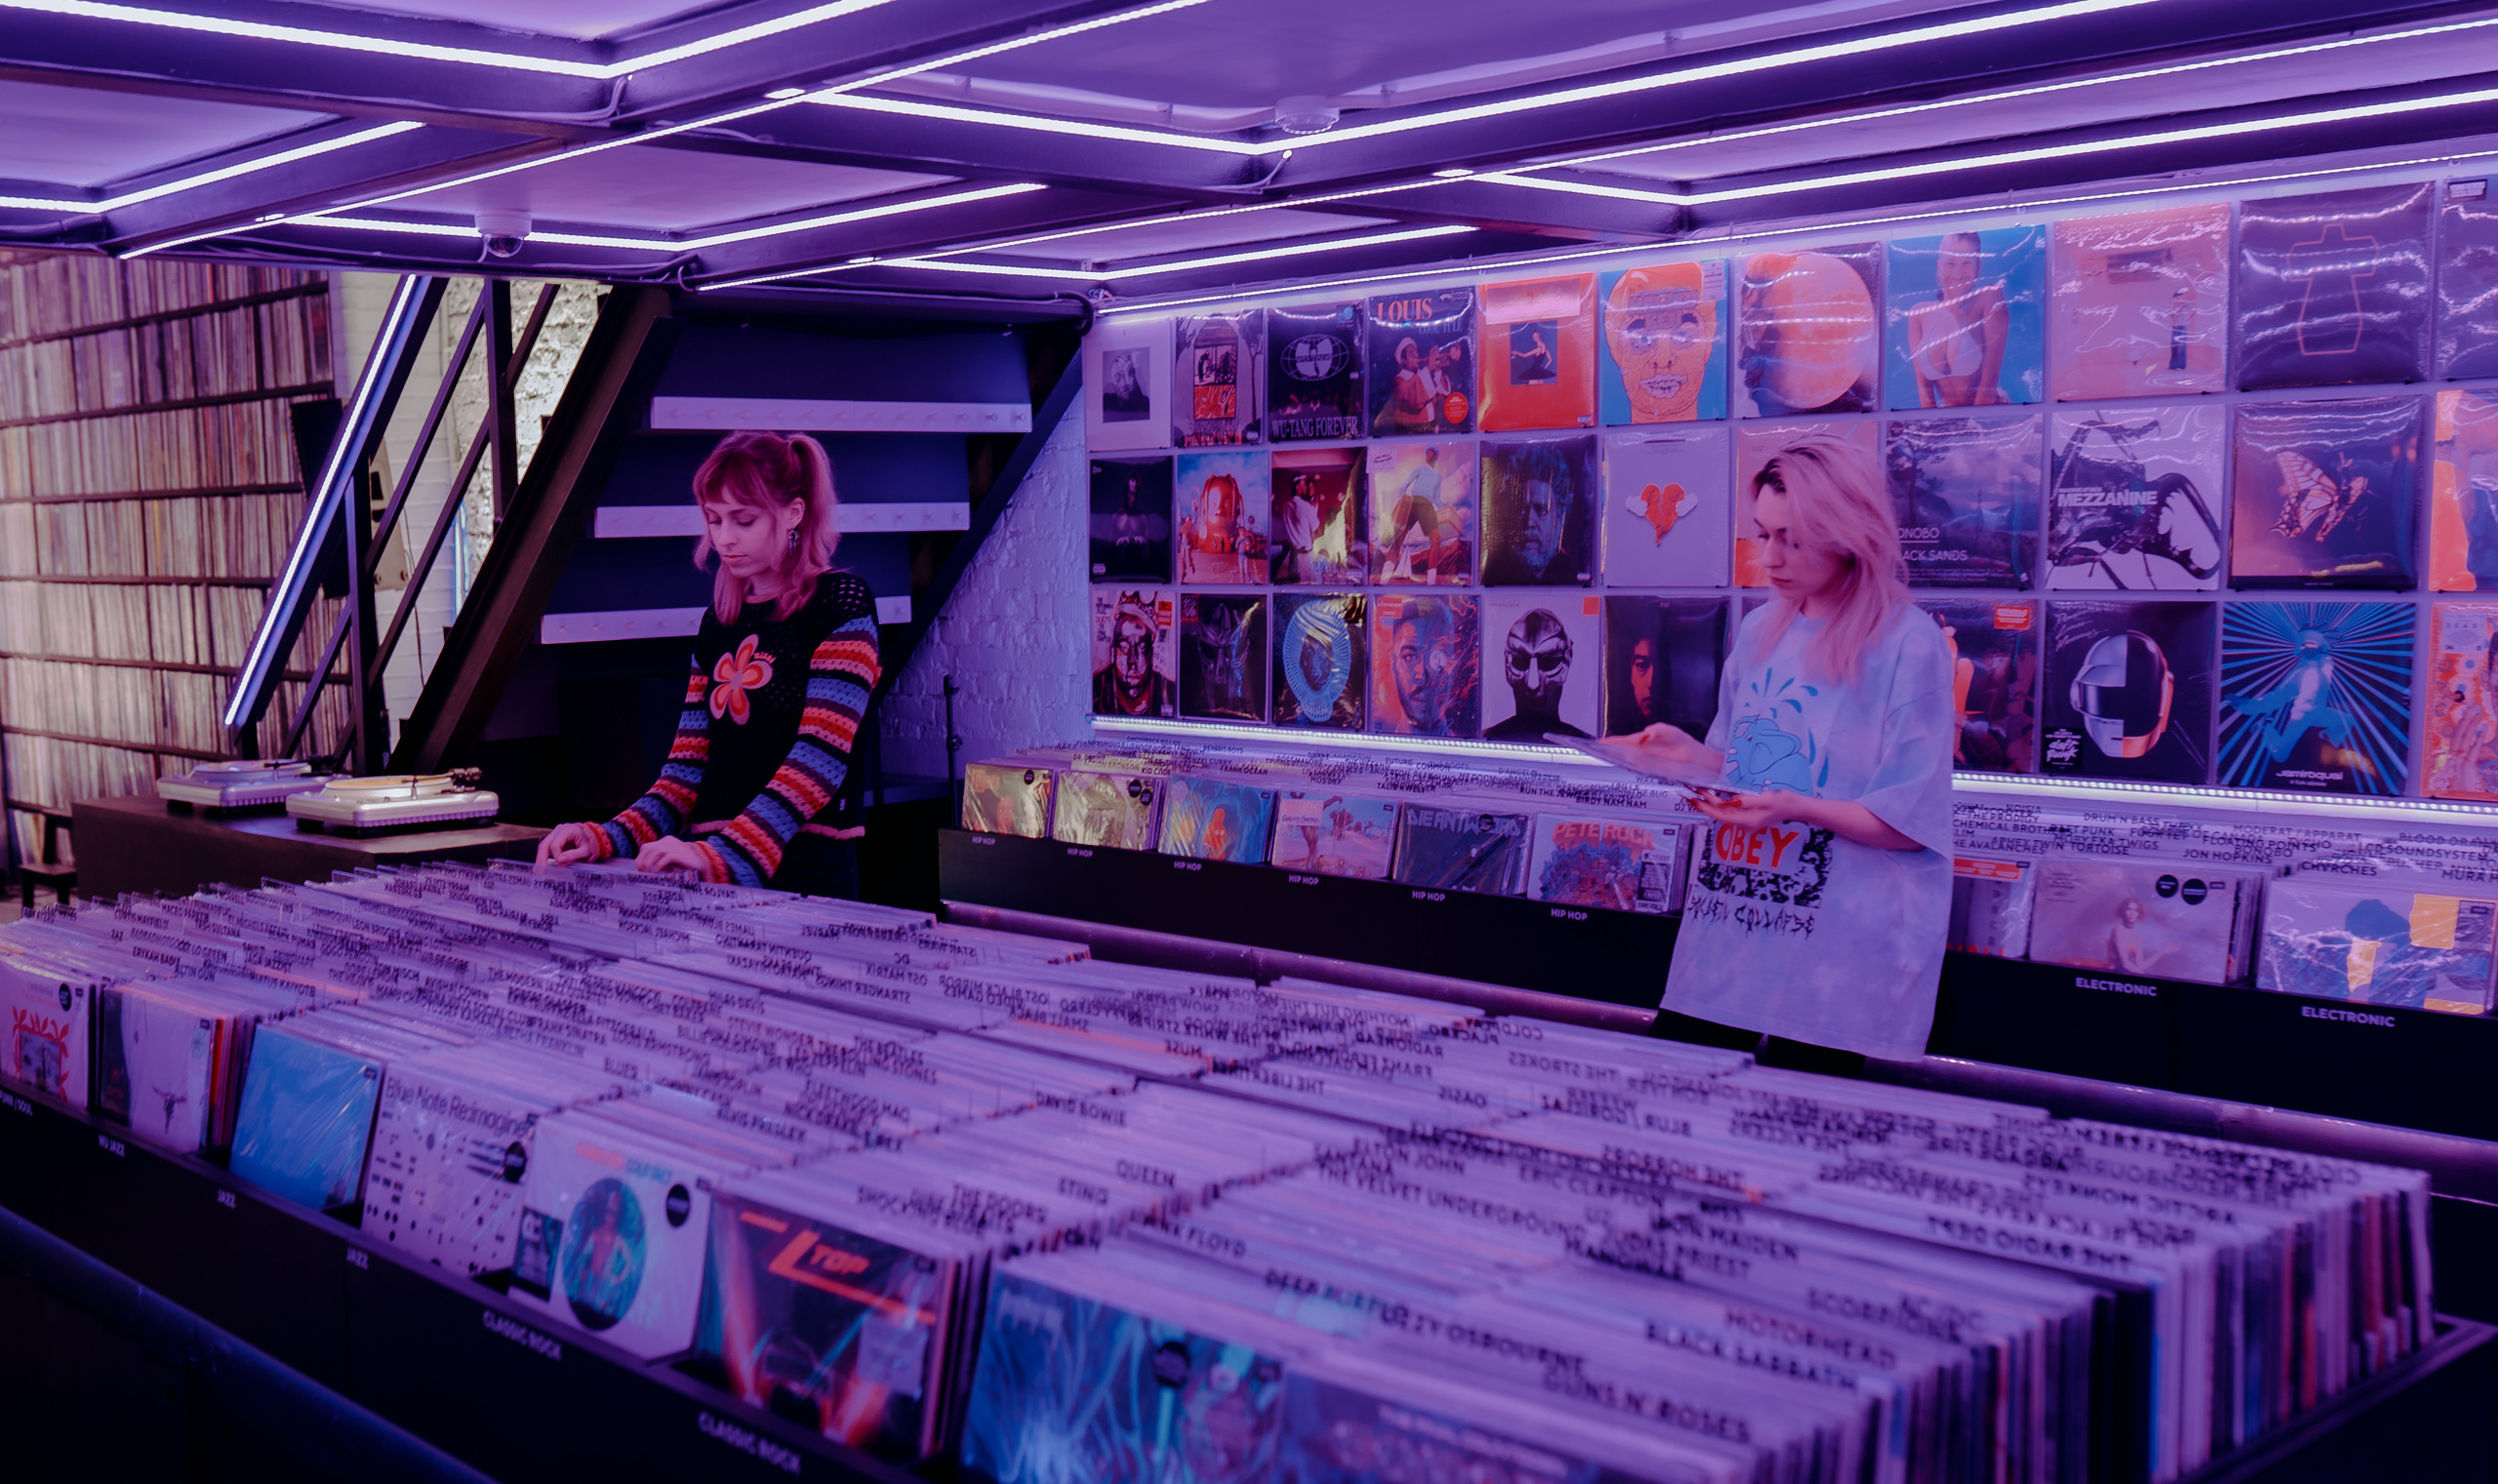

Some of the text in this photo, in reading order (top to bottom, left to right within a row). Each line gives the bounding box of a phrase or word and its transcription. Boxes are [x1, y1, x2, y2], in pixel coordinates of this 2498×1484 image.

[1377, 298, 1432, 322] LOUIS
[1271, 416, 1358, 439] WU-TANG FOREVER
[2057, 491, 2159, 507] MEZZANINE
[1895, 527, 1941, 540] ONOBO
[1928, 549, 1969, 562] SANDS
[1385, 756, 1414, 766] FUTURE
[1416, 762, 1451, 772] COMMON
[1603, 798, 1625, 808] NAM
[1627, 800, 1647, 810] NAM
[1953, 819, 2009, 831] CHEMICAL
[1990, 812, 2039, 823] PRODIGY
[2083, 812, 2160, 825] DRUM BASS
[1551, 822, 1657, 848] PETE ROCK
[2086, 826, 2115, 837] PUNK
[2233, 824, 2362, 842] MODERAT APPARAT
[971, 835, 995, 846] HIP HOP
[1715, 823, 1800, 868] OBEY
[2118, 837, 2158, 851] TWIGS
[1068, 847, 1093, 858] HIP HOP
[2070, 842, 2130, 857] TORTOISE
[2182, 848, 2273, 864] JON HOPKINS
[1173, 861, 1202, 872] HIP HOP
[1288, 874, 1319, 886] HIP HOP
[2441, 868, 2485, 883] MURA
[1411, 891, 1446, 902] HIP HOP
[1551, 908, 1589, 921] HIP HOP
[2075, 977, 2158, 998] ELECTRONIC
[2301, 1006, 2397, 1028] ELECTRONIC
[603, 1056, 640, 1080] BLUES
[385, 1077, 448, 1115] Blue Note
[1035, 1089, 1128, 1128] DAVID BOWIE
[1415, 1151, 1466, 1177] JOHN
[1116, 1157, 1177, 1189] QUEEN
[1058, 1176, 1110, 1208] STING
[1187, 1226, 1247, 1259] FLOYD
[809, 1243, 871, 1275] TOP
[1265, 1267, 1320, 1296] DEEP
[482, 1310, 563, 1363] CLASSIC ROCK
[698, 1410, 803, 1477] CLASSIC ROCK
